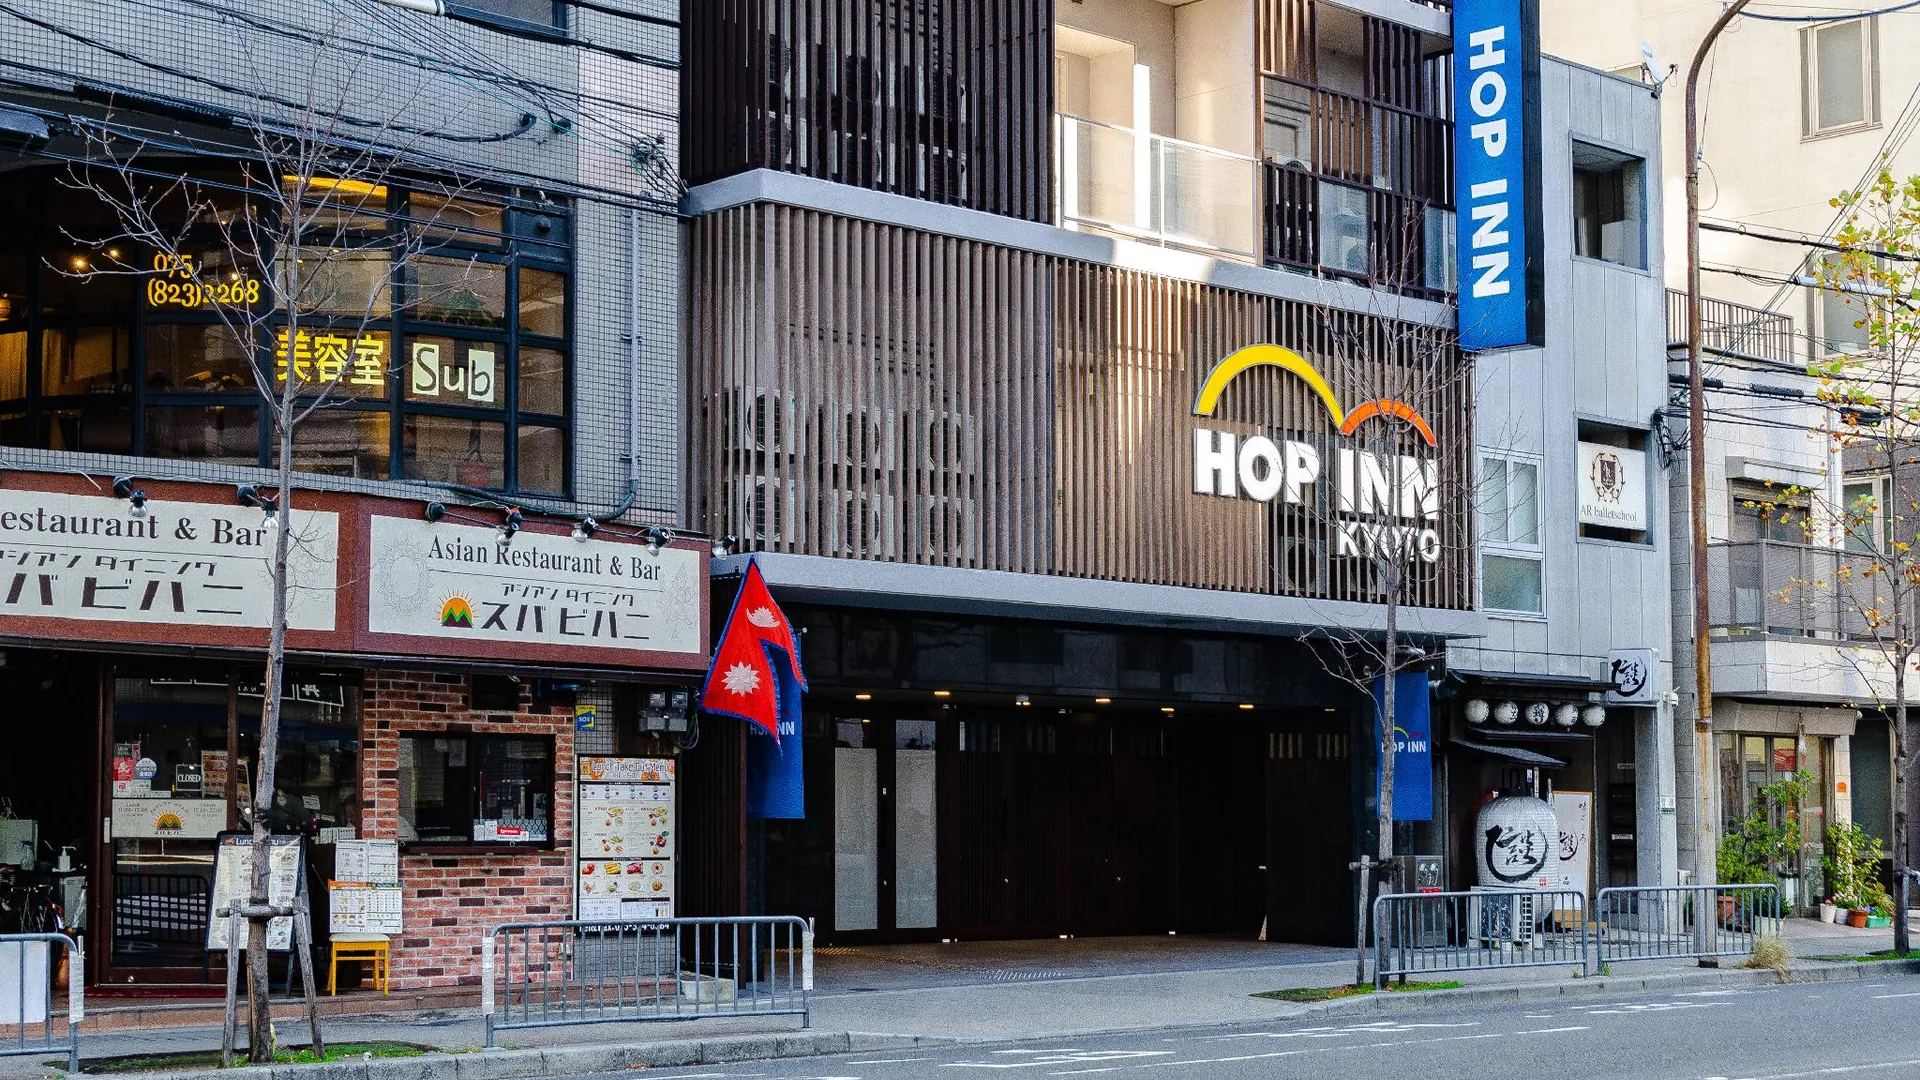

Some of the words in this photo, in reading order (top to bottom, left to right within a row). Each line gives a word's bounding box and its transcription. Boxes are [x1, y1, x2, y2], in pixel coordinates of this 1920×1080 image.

[1470, 25, 1507, 158] HOP
[1471, 178, 1510, 299] INN
[153, 253, 194, 279] 075
[277, 329, 385, 386] 美容室
[412, 343, 495, 402] Sub
[1193, 428, 1320, 504] HOP
[1338, 448, 1439, 520] INN
[174, 517, 198, 541] &
[210, 518, 268, 547] Bar
[1580, 504, 1593, 517] AR
[1594, 507, 1637, 522] balletschool
[428, 534, 489, 564] Asian
[496, 541, 603, 575] Restaurant
[609, 555, 624, 576] &
[631, 556, 661, 581] Bar
[1338, 519, 1441, 563] KYOTO
[480, 601, 650, 640] スバビハニ
[1407, 740, 1427, 753] INN
[177, 774, 201, 783] CLOSED
